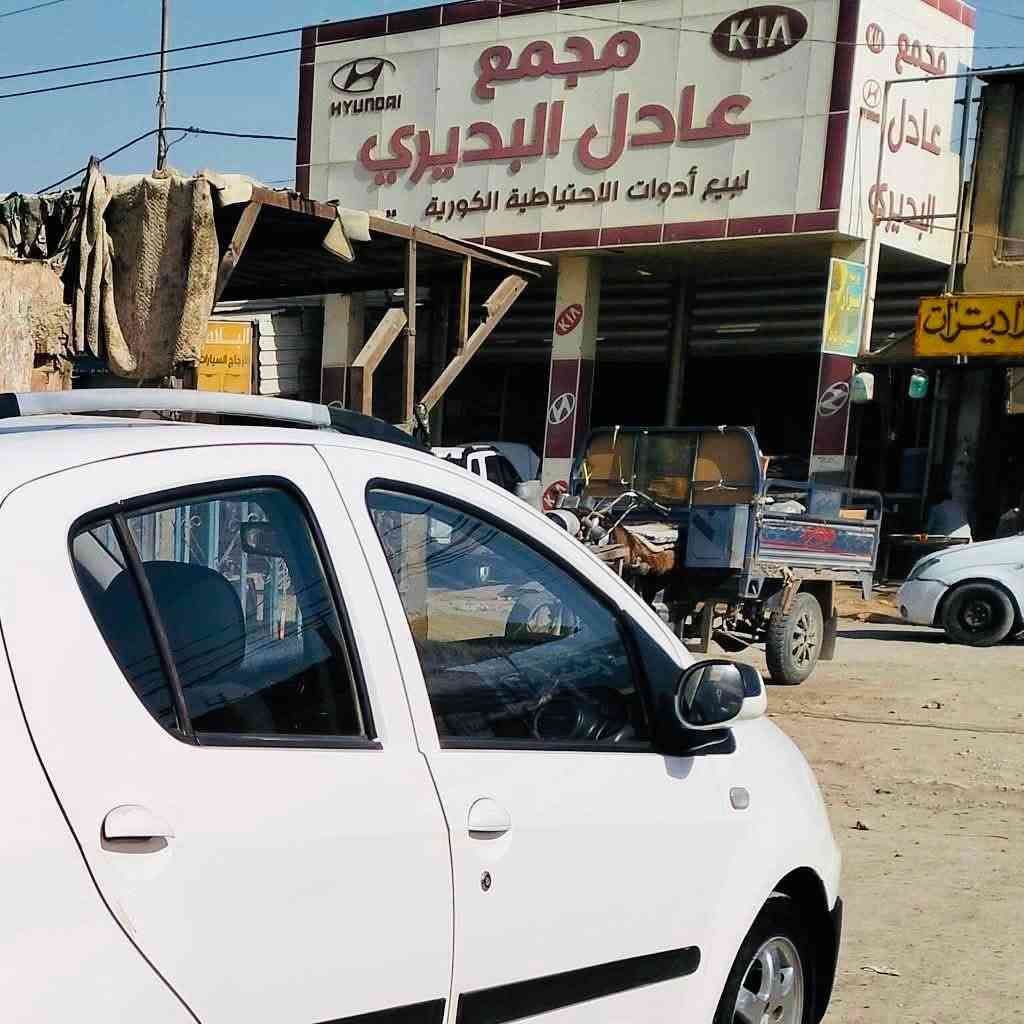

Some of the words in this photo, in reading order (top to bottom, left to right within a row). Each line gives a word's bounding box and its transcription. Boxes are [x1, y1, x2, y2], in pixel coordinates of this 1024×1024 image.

[728, 14, 793, 52] KIA
[475, 31, 641, 99] مجمع
[895, 33, 947, 75] مجمع
[330, 95, 401, 117] HYUNDAI
[887, 98, 942, 155] عادل
[360, 101, 564, 184] البديري
[578, 85, 752, 170] عادل
[424, 190, 499, 220] الكورية
[627, 165, 698, 206] أدوات
[702, 169, 750, 200] لبيع
